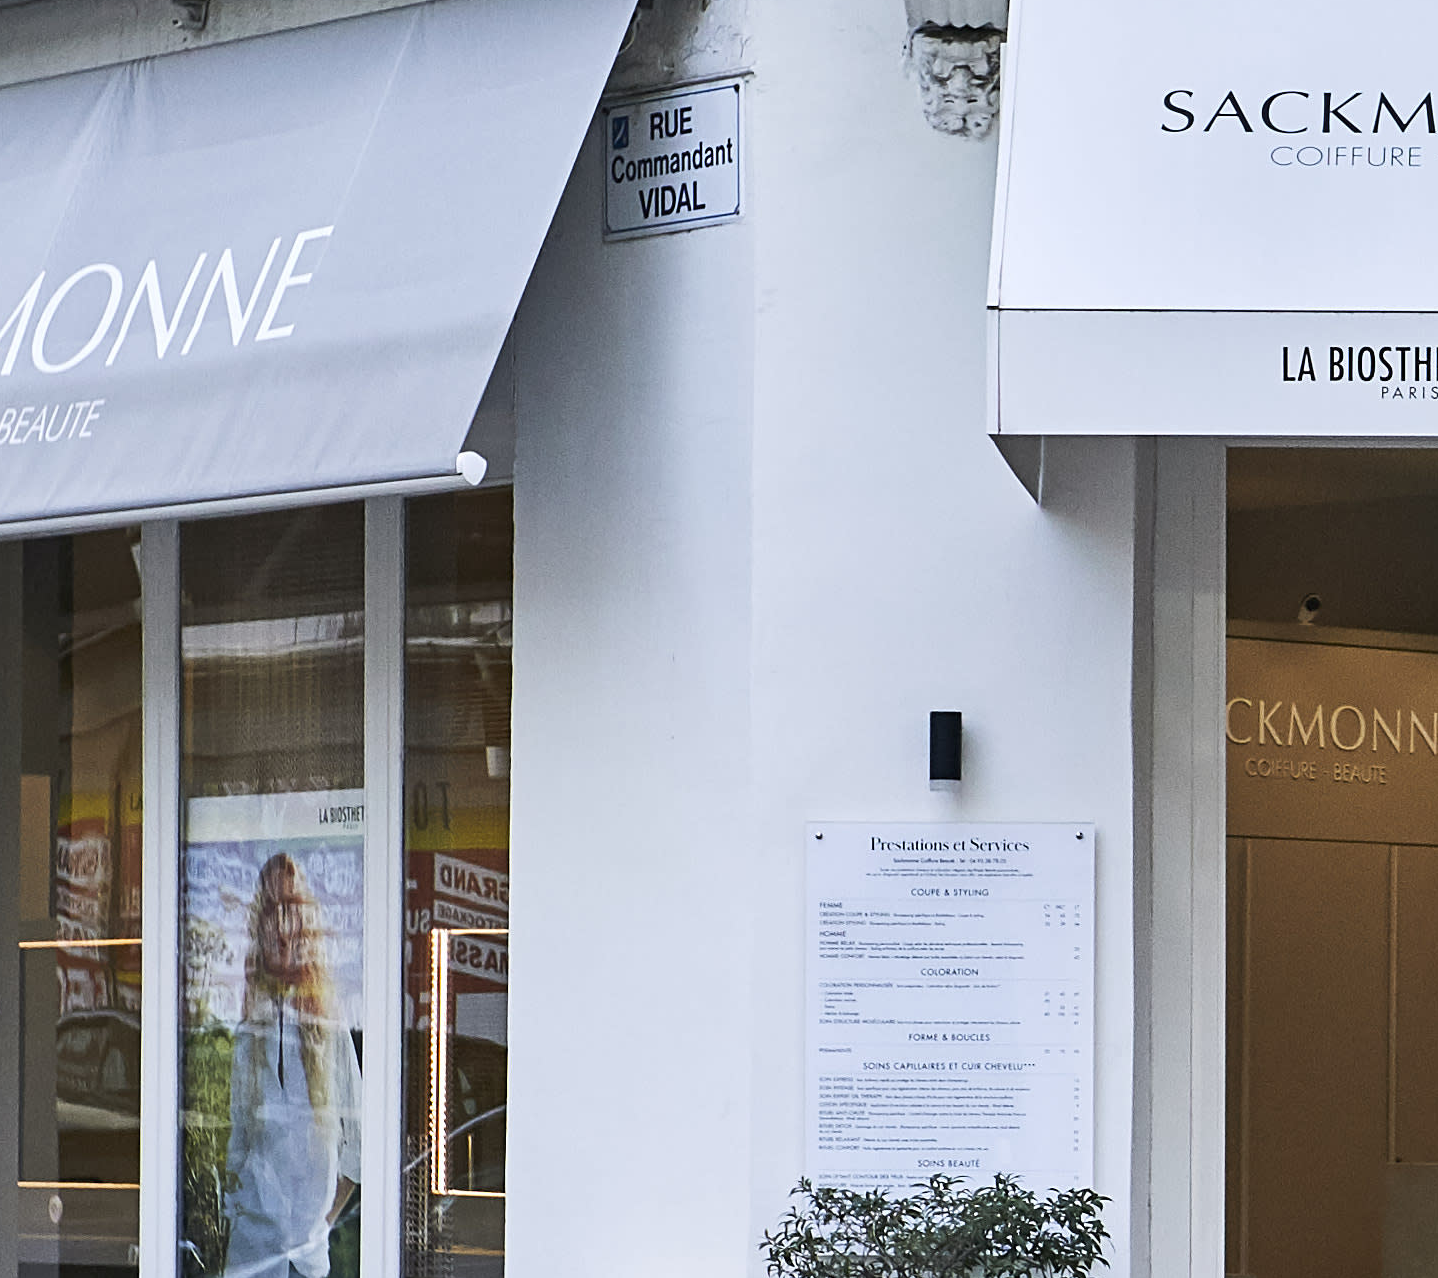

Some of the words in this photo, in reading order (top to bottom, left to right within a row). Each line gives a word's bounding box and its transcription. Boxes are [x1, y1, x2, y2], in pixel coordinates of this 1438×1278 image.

[650, 106, 692, 140] RUE
[612, 138, 733, 183] Commandant
[1270, 146, 1422, 167] COIFFURE
[639, 181, 706, 219] VIDAL
[1282, 346, 1316, 381] LA
[1245, 757, 1316, 780] COIFFURE
[1333, 762, 1387, 784] BEAUTE
[870, 836, 949, 852] Prestations
[952, 839, 964, 852] et
[969, 836, 1030, 852] Services
[911, 888, 941, 897] COUPE
[953, 888, 989, 897] STYLING
[920, 968, 979, 976] COLORATION
[908, 1033, 938, 1042] FORME
[951, 1033, 991, 1042] BOUCLES
[862, 1062, 891, 1070] SOINS
[894, 1062, 946, 1070] CAPILLAIRES
[948, 1062, 958, 1070] ET
[962, 1062, 981, 1071] CUIR
[917, 1159, 945, 1167] SOINS
